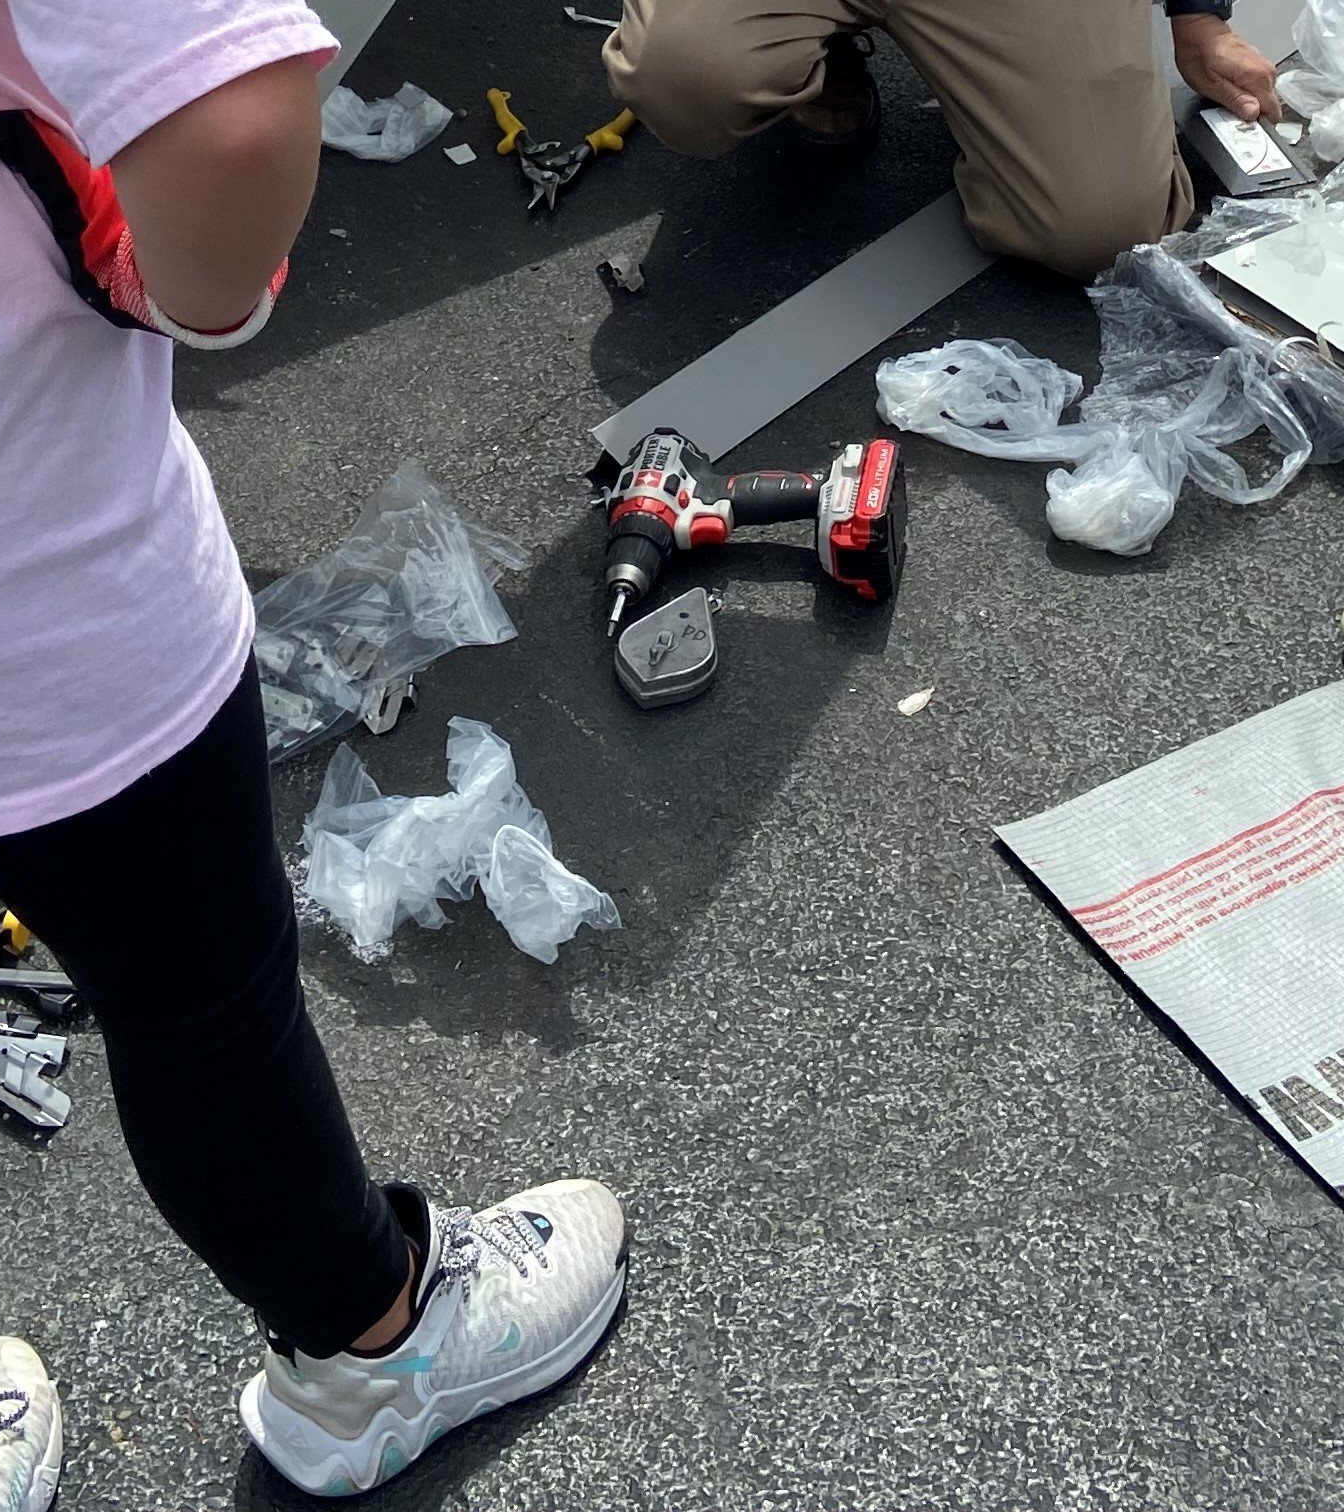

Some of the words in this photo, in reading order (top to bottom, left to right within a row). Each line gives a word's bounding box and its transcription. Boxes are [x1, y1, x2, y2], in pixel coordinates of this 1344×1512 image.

[640, 438, 660, 469] PORTER
[866, 486, 879, 508] 20V
[874, 448, 889, 487] LITHIUM
